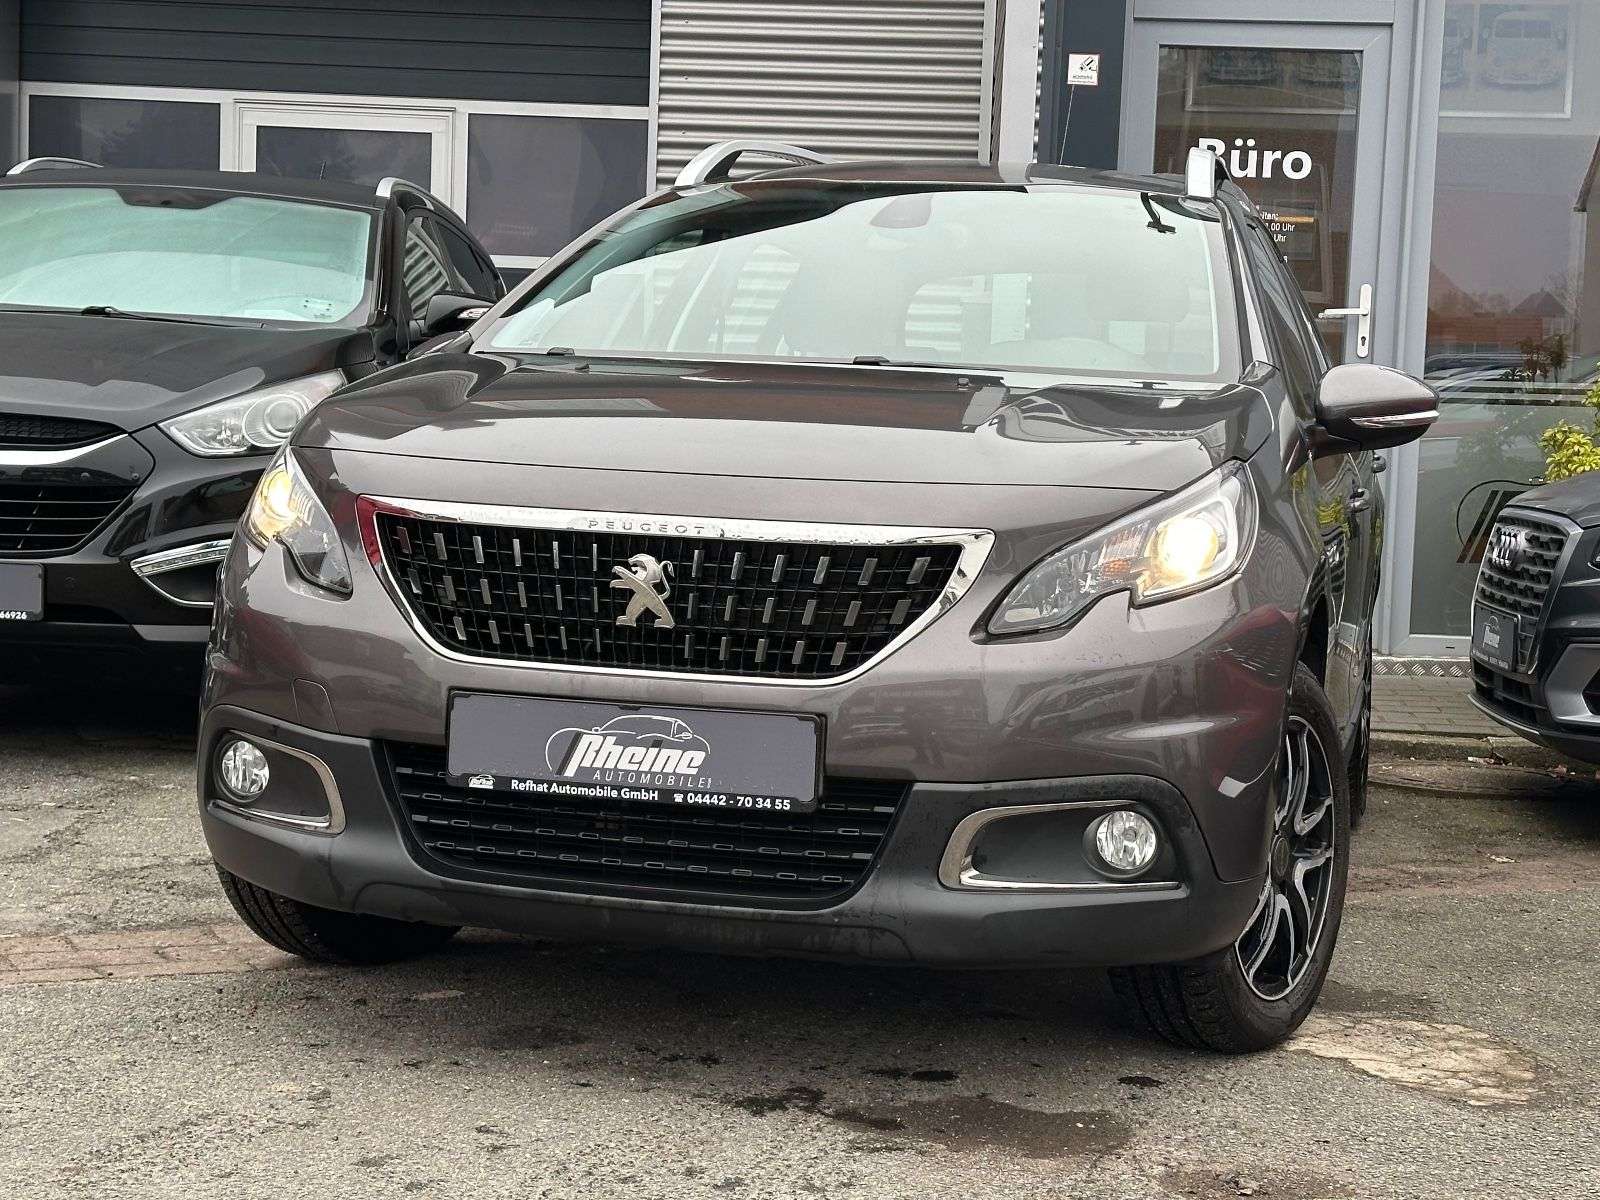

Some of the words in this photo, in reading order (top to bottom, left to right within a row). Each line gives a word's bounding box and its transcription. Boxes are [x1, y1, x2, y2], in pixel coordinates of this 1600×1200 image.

[1282, 222, 1296, 232] Uhr
[1273, 233, 1287, 242] Uhr
[588, 519, 705, 535] PEUGEOT
[563, 733, 706, 778] Rheine
[593, 770, 707, 789] AUTOMOBILE
[511, 779, 549, 793] Refhat
[549, 782, 619, 798] Automobile
[620, 787, 659, 801] GmbH
[686, 792, 727, 806] 04442
[736, 795, 753, 808] 70
[755, 797, 772, 809] 34
[774, 799, 791, 811] 55
